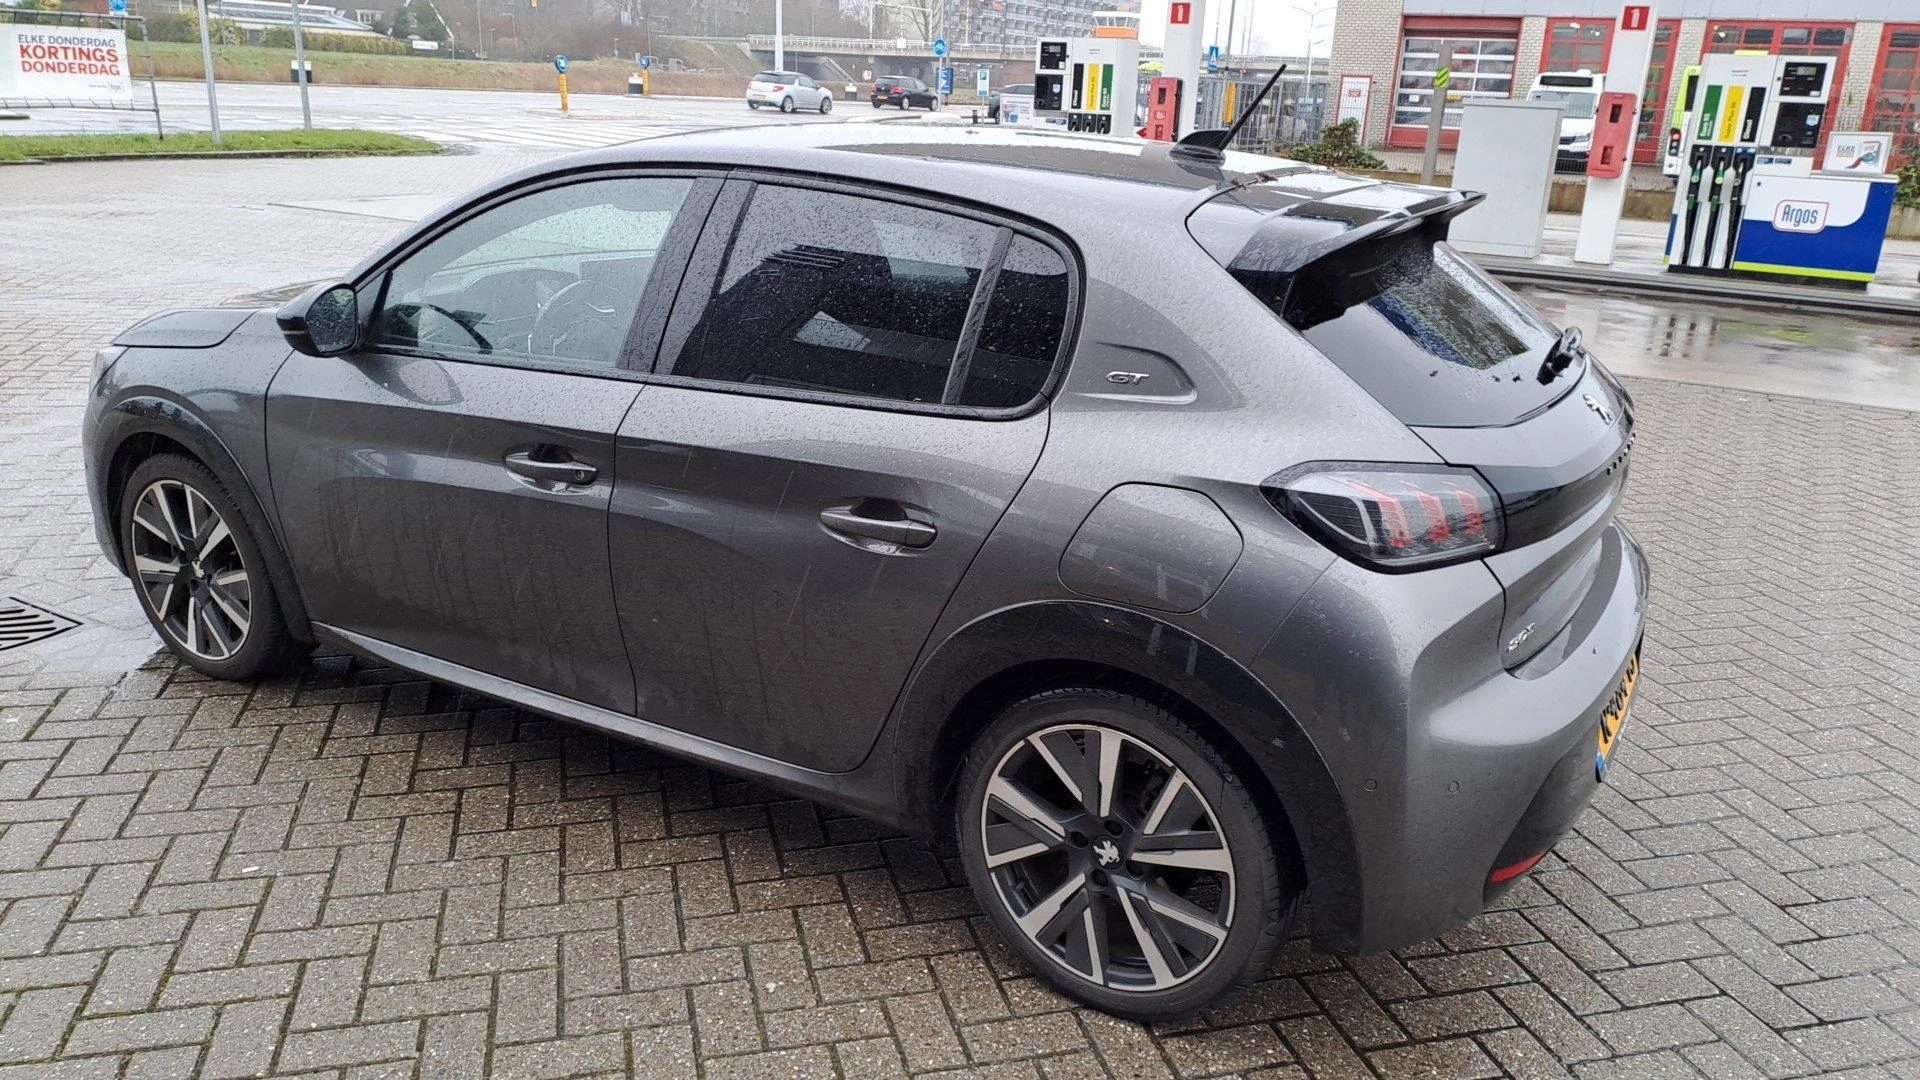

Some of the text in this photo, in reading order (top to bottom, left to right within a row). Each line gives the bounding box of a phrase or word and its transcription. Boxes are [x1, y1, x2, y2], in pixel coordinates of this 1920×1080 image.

[18, 34, 116, 47] ELKE DONDERDAG
[20, 44, 119, 62] KORTINGS
[22, 61, 120, 76] DONDERDAG
[1700, 121, 1709, 137] Euro
[1743, 119, 1752, 139] Diesel
[1781, 204, 1819, 227] Argos
[1106, 371, 1150, 385] GT
